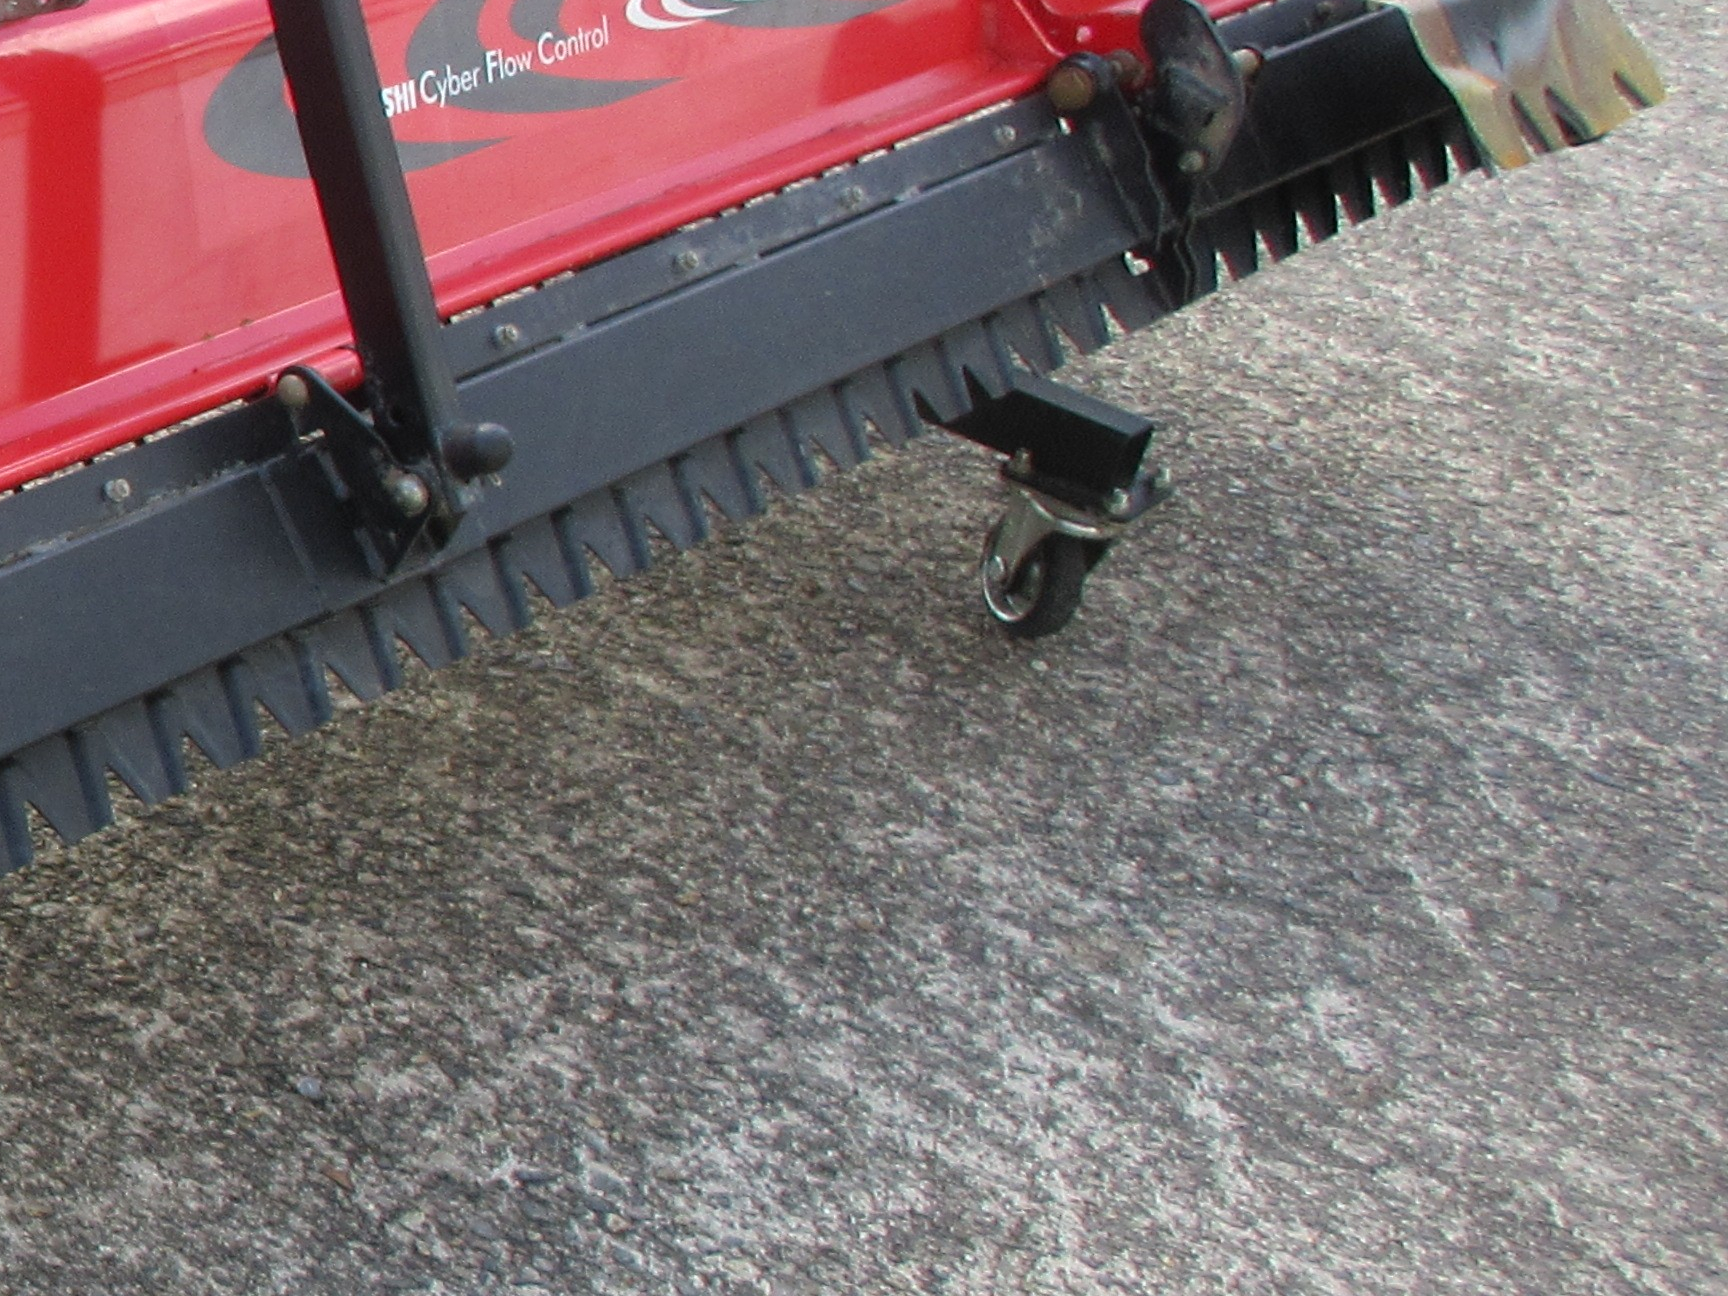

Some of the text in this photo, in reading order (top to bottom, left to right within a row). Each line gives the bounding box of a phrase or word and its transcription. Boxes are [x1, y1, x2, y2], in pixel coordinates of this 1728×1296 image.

[419, 65, 482, 107] Cyber
[485, 49, 533, 84] Flow
[537, 15, 609, 65] Control
